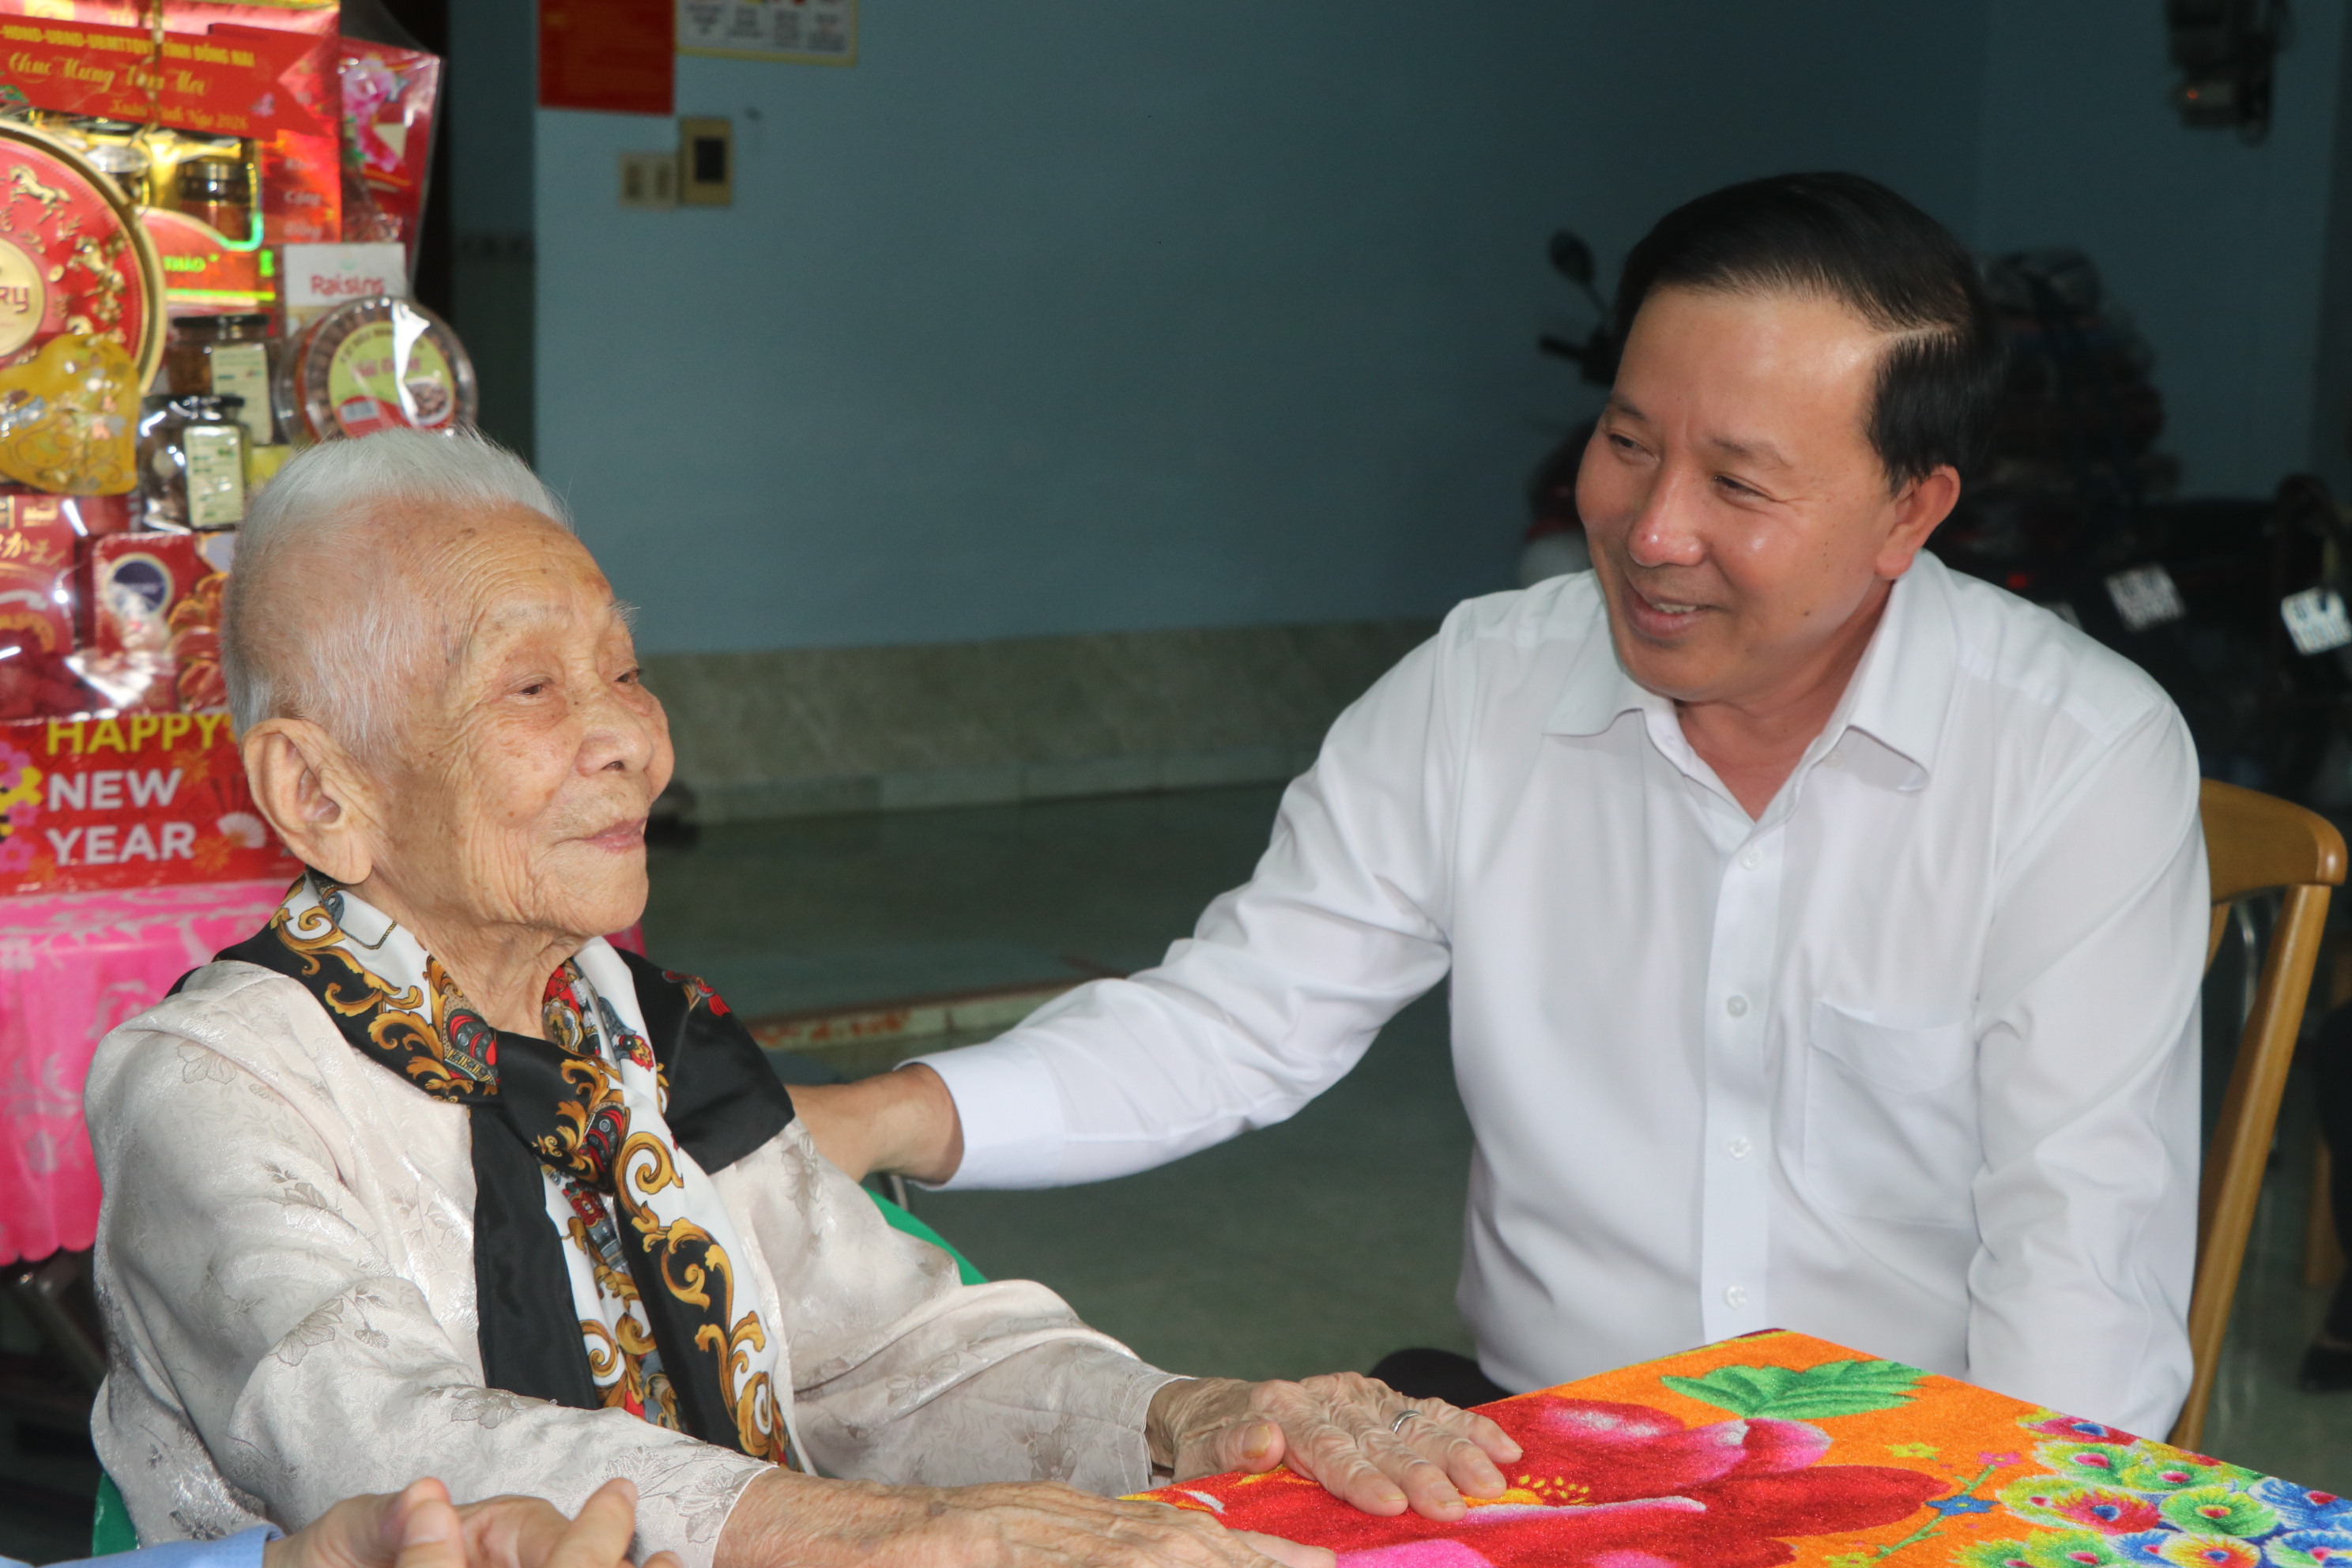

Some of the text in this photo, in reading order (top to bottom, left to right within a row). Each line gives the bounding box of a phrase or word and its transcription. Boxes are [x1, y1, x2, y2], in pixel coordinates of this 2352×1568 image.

[311, 273, 385, 298] Raisins
[47, 714, 224, 756] HAPPY
[49, 767, 183, 812] NEW
[45, 822, 196, 866] YEAR
